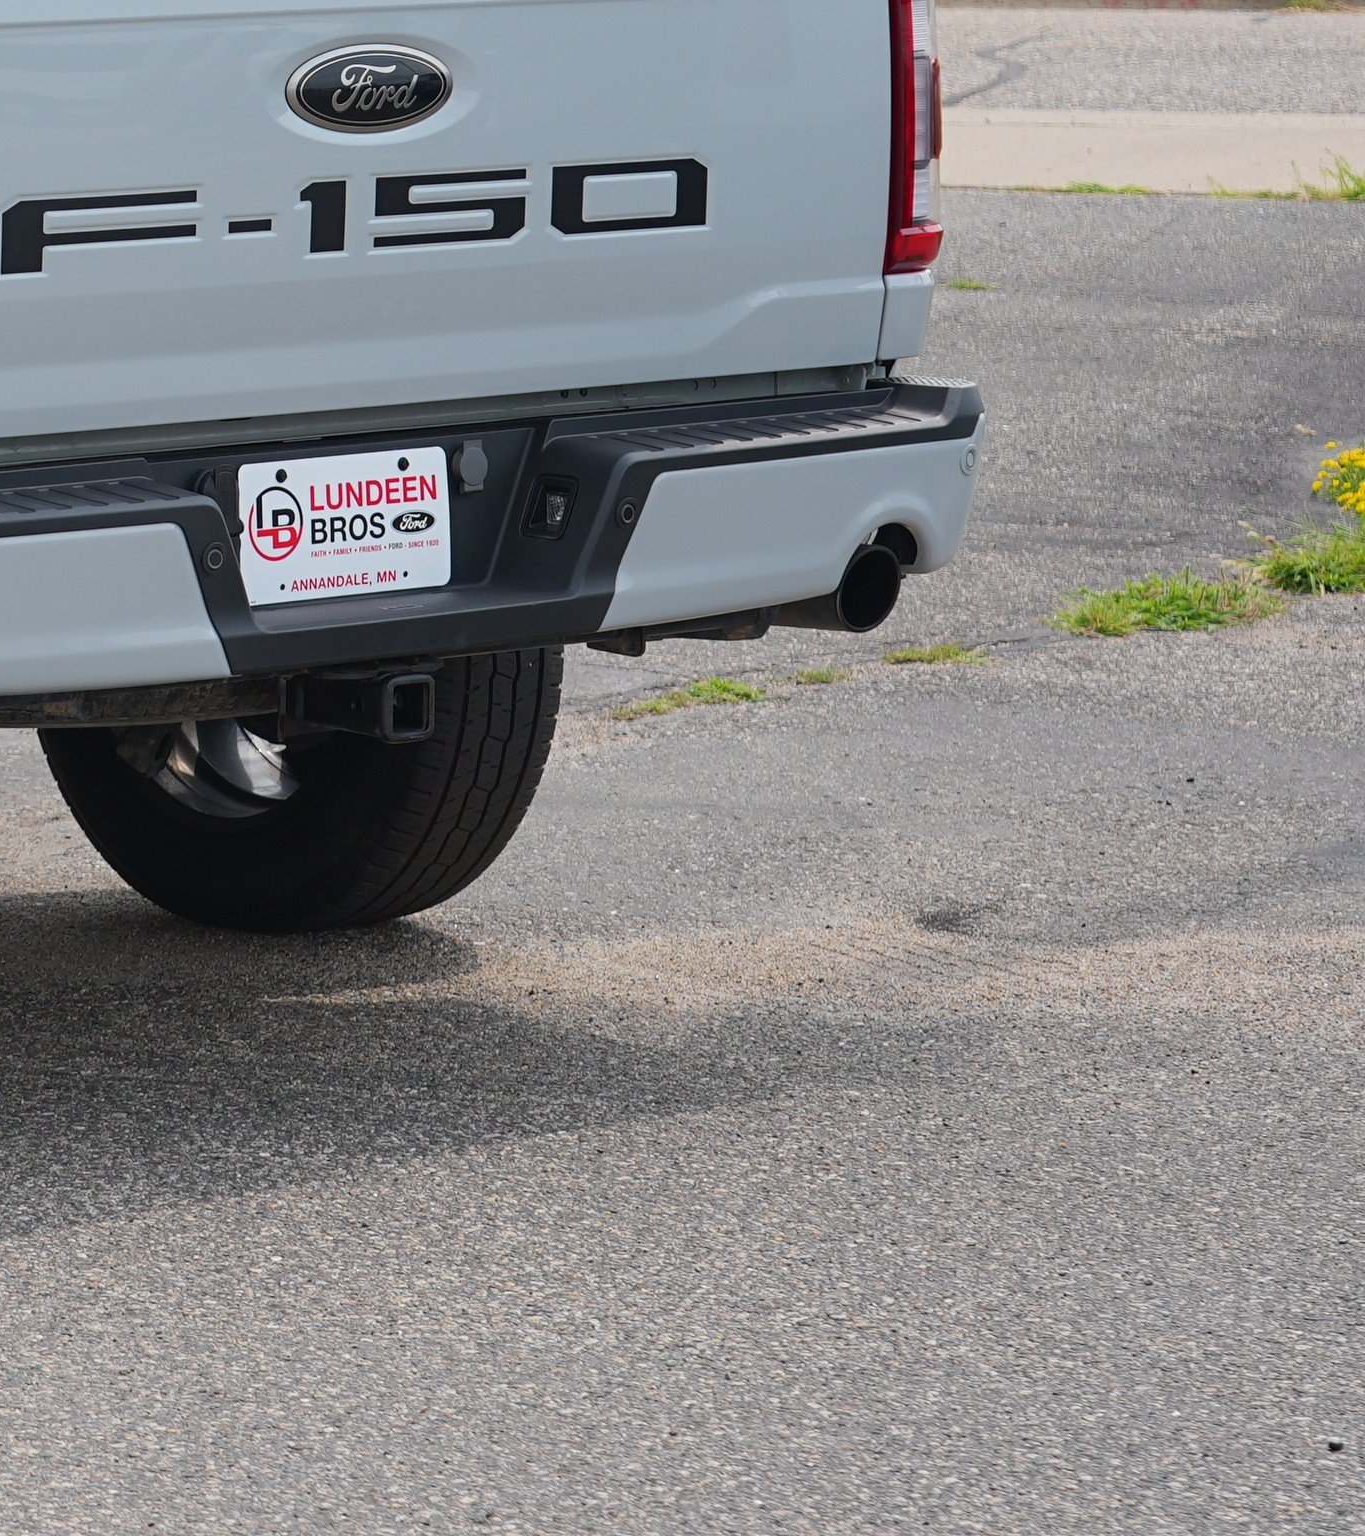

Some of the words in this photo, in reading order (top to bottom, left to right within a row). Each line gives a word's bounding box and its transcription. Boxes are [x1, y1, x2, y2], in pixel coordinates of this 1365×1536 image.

[331, 64, 419, 112] Ford
[0, 158, 709, 276] F-150
[310, 474, 437, 511] LUNDEEN
[311, 512, 386, 545] BROS
[311, 550, 327, 558] FAITH
[333, 547, 353, 556] FAMILY
[358, 543, 383, 553] FRIENDS
[388, 541, 404, 550] FORD
[408, 540, 425, 549] SINCE
[426, 539, 439, 547] 1920
[290, 572, 373, 592] ANNANDALE,
[376, 569, 397, 583] MN
